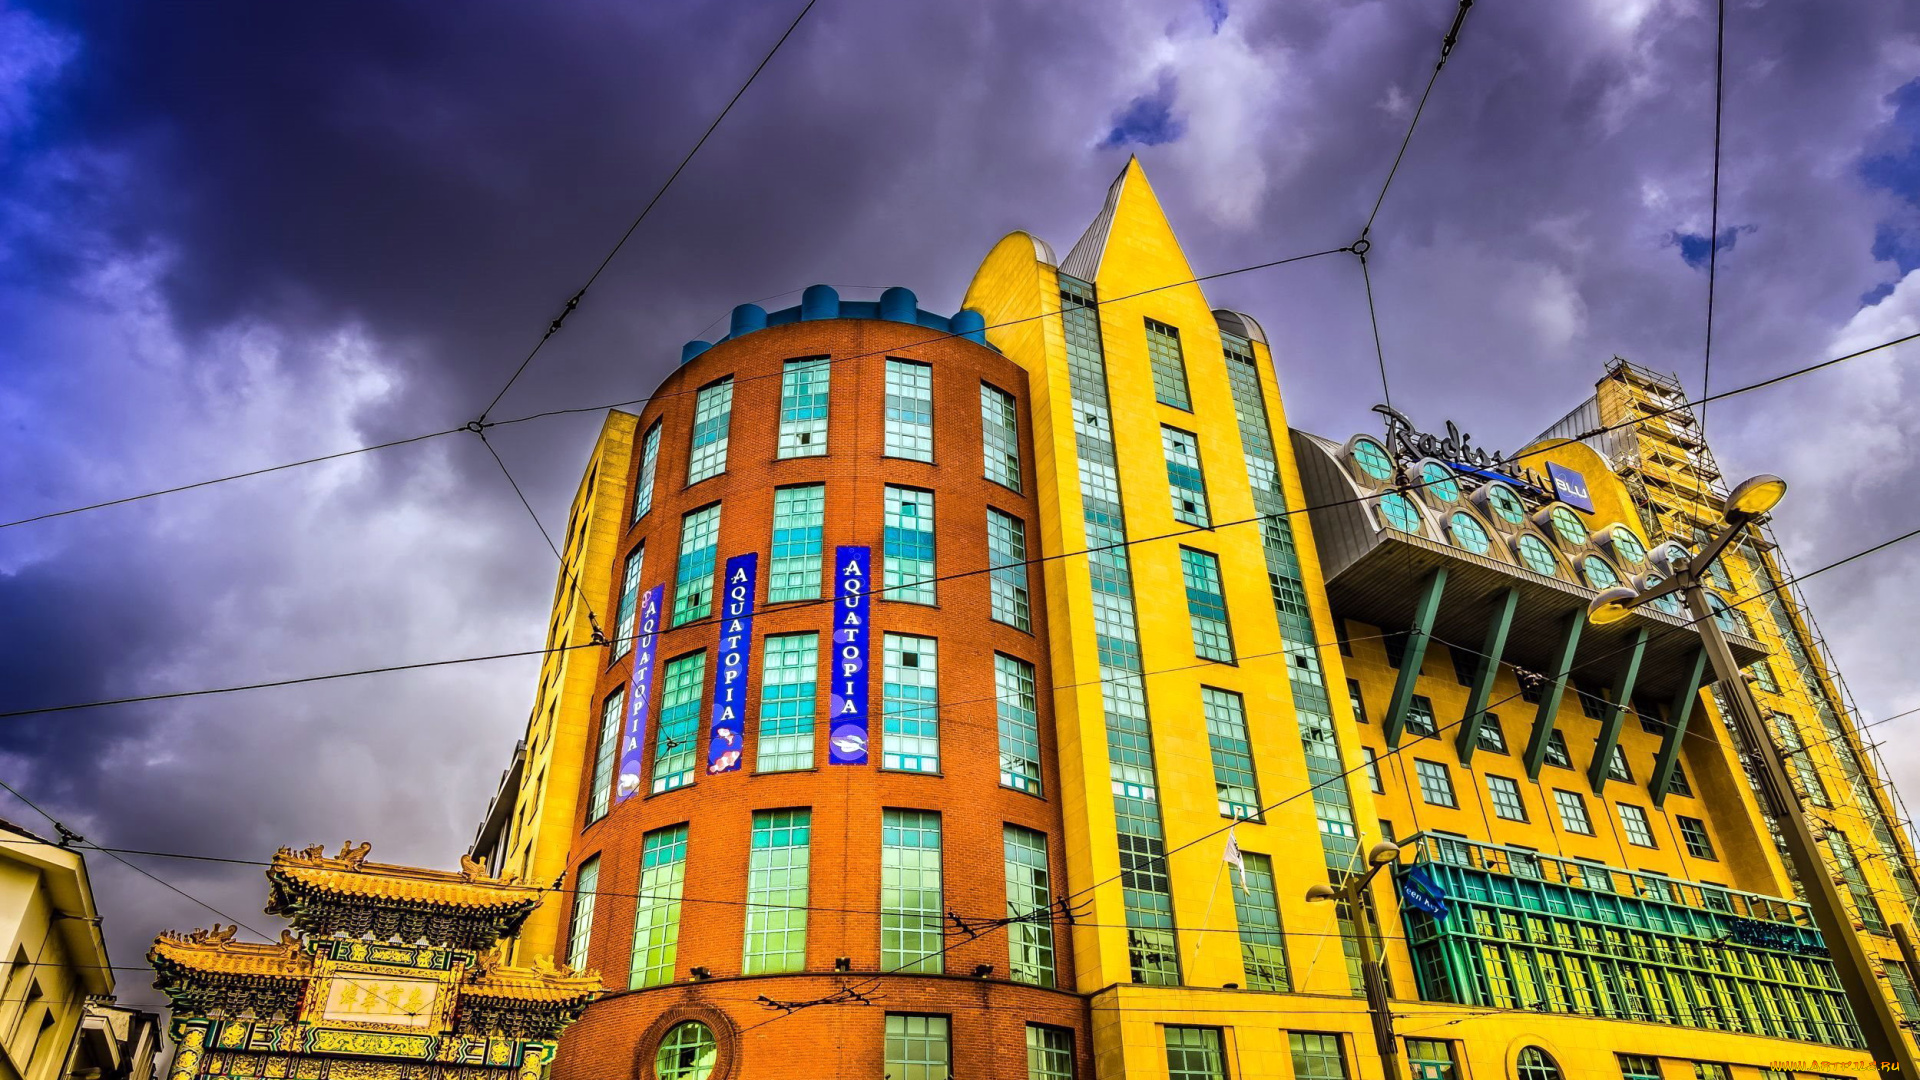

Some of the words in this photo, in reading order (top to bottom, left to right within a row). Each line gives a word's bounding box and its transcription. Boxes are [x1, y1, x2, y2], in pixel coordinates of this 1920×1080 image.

[1371, 404, 1555, 495] Radisson
[1554, 477, 1588, 499] BLU
[626, 601, 657, 752] AQUATOPIA
[720, 567, 748, 721] AQUATOPIA
[840, 560, 862, 714] AQUATOPIA
